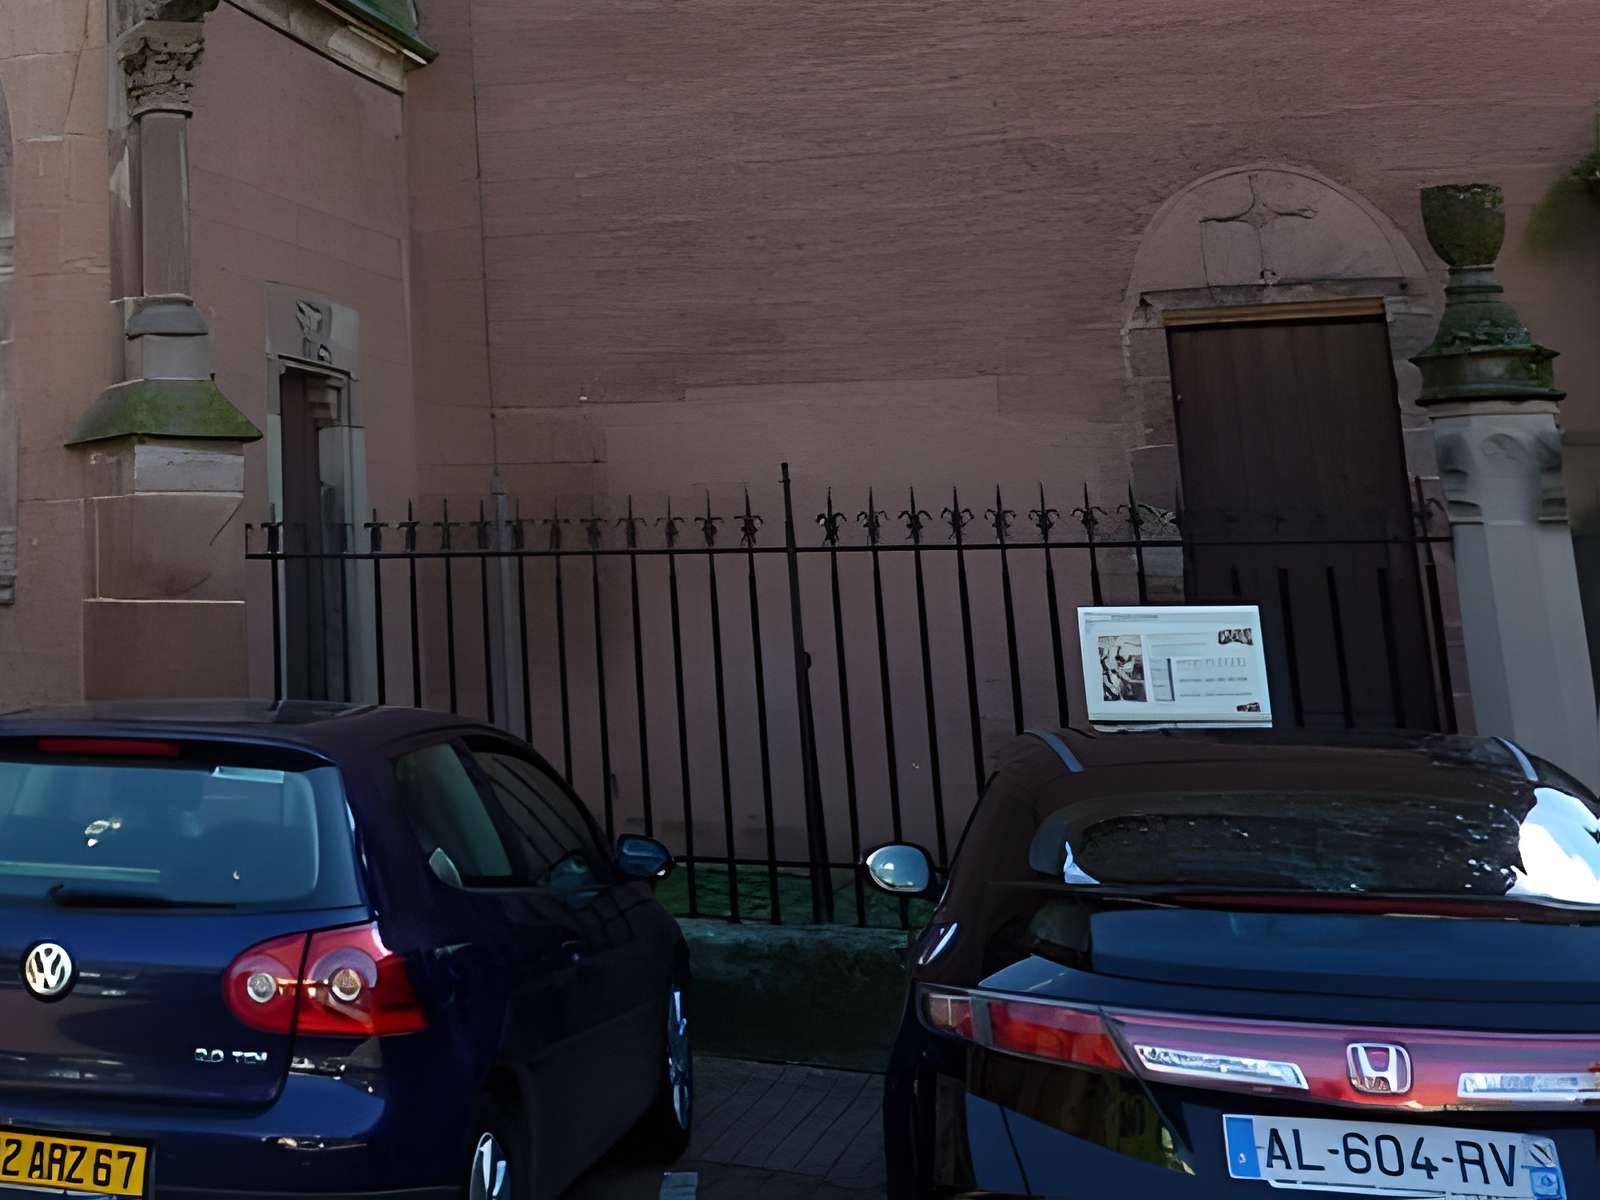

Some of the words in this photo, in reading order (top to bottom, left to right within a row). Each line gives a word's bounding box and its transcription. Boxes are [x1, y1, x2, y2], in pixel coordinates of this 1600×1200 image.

[27, 1140, 88, 1184] ARZ
[93, 1148, 137, 1190] 67
[1266, 1127, 1516, 1187] AL-604-RV
